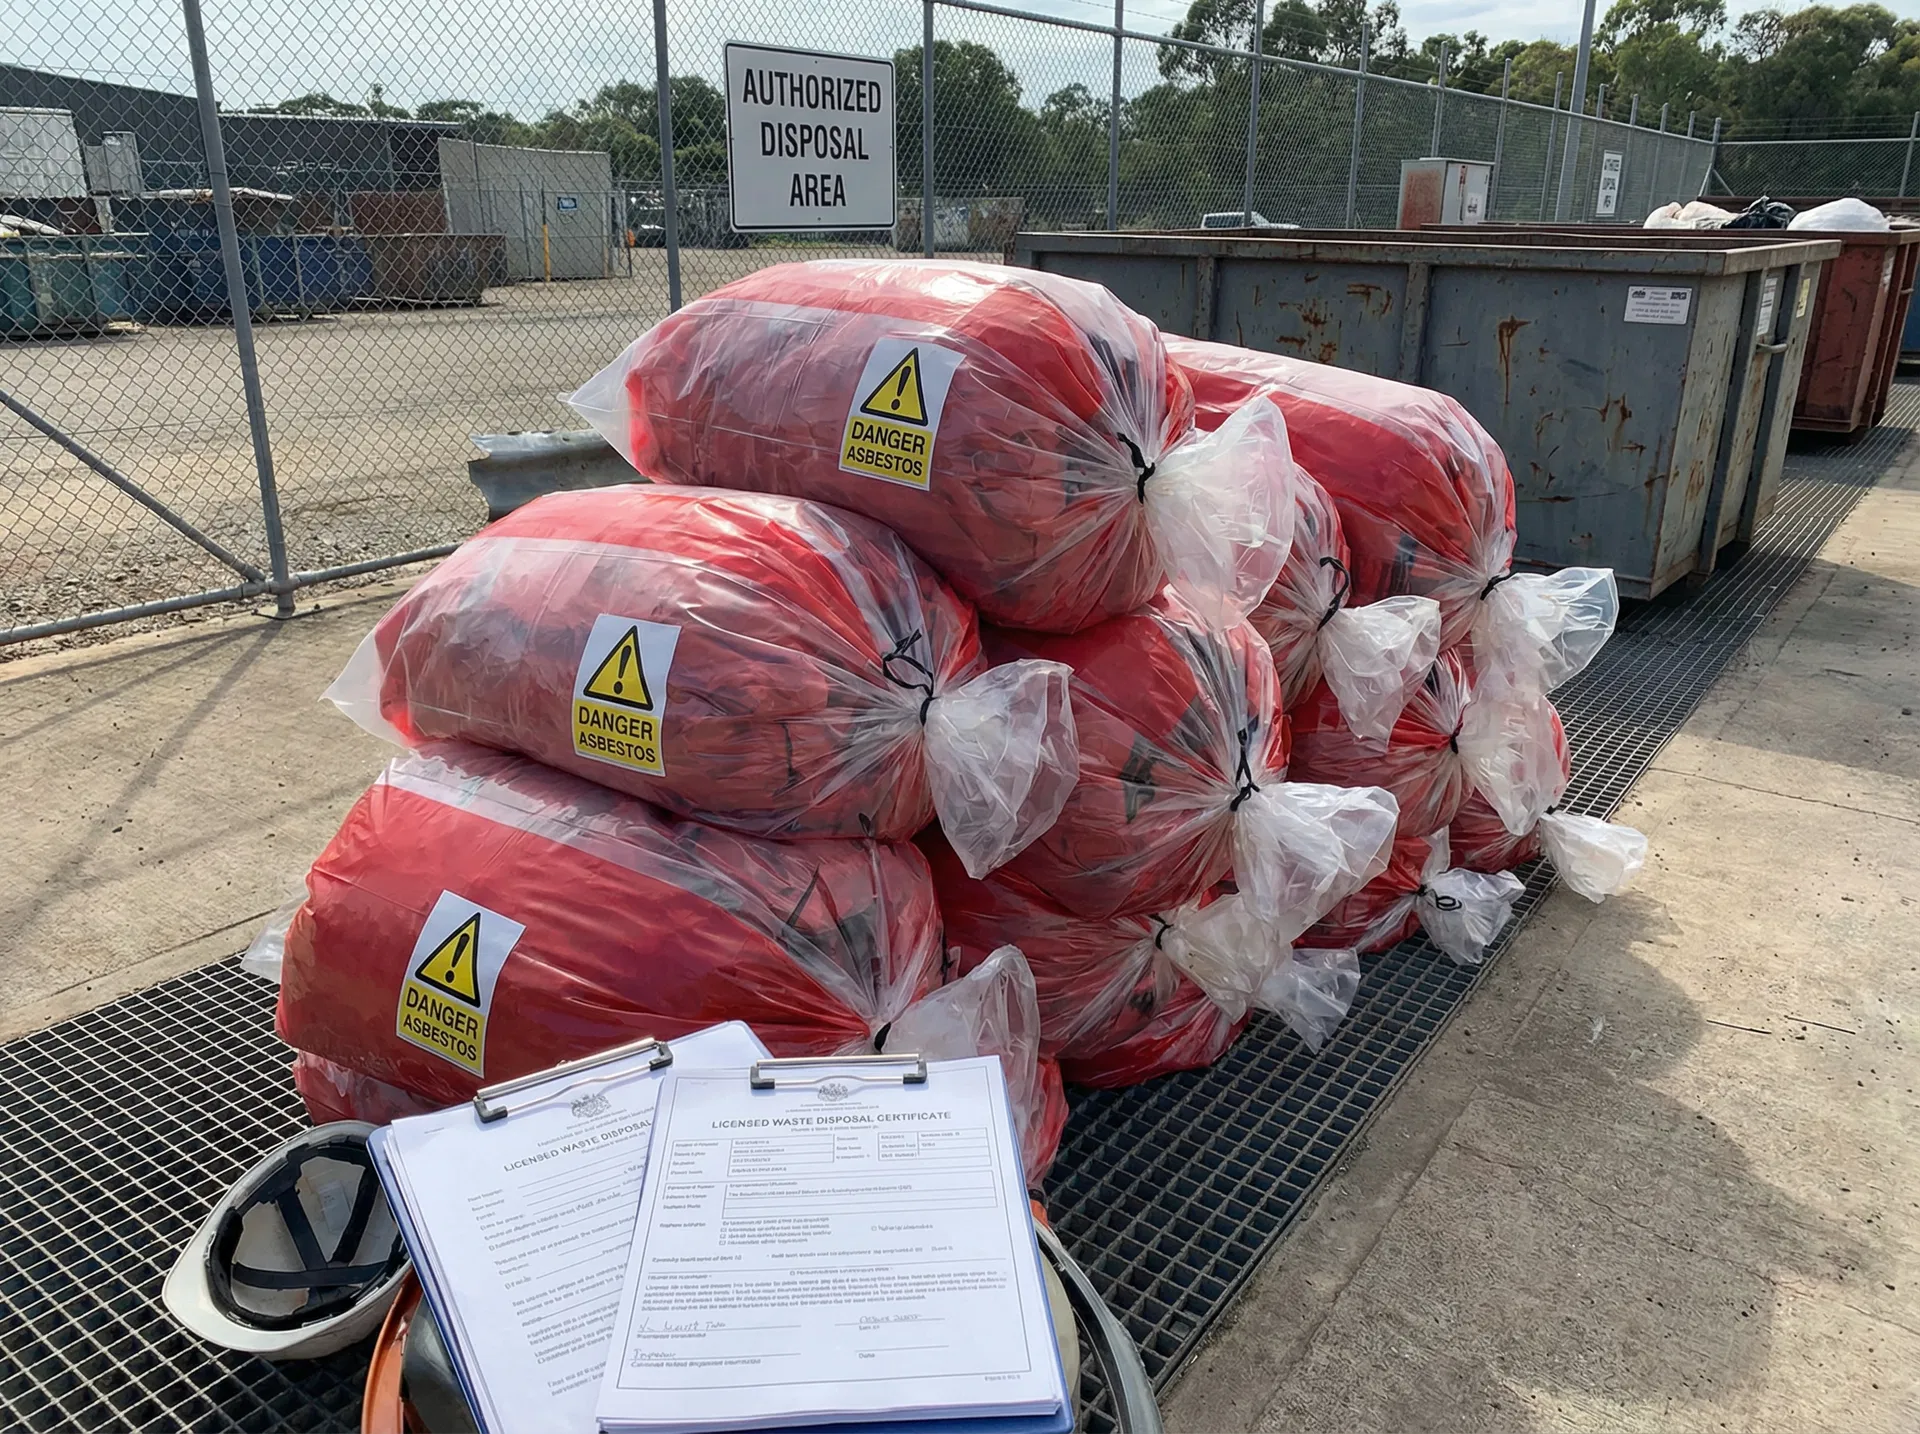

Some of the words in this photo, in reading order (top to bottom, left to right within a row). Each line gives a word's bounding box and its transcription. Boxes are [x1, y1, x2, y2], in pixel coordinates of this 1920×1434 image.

[742, 68, 882, 113] AUTHORIZED
[760, 121, 869, 160] DISPOSAL
[789, 173, 847, 207] AREA
[851, 421, 926, 455] DANGER
[846, 445, 923, 477] ASBESTOS
[578, 706, 653, 741] DANGER
[579, 731, 656, 763] ASBESTOS
[406, 987, 479, 1040] DANGER
[403, 1014, 477, 1062] ASBESTOS
[711, 1118, 770, 1129] LICENSED
[772, 1116, 814, 1126] WASTE
[816, 1114, 874, 1125] DISPOSAL
[876, 1111, 952, 1122] CERTIFICATE
[560, 1136, 600, 1154] WASTE
